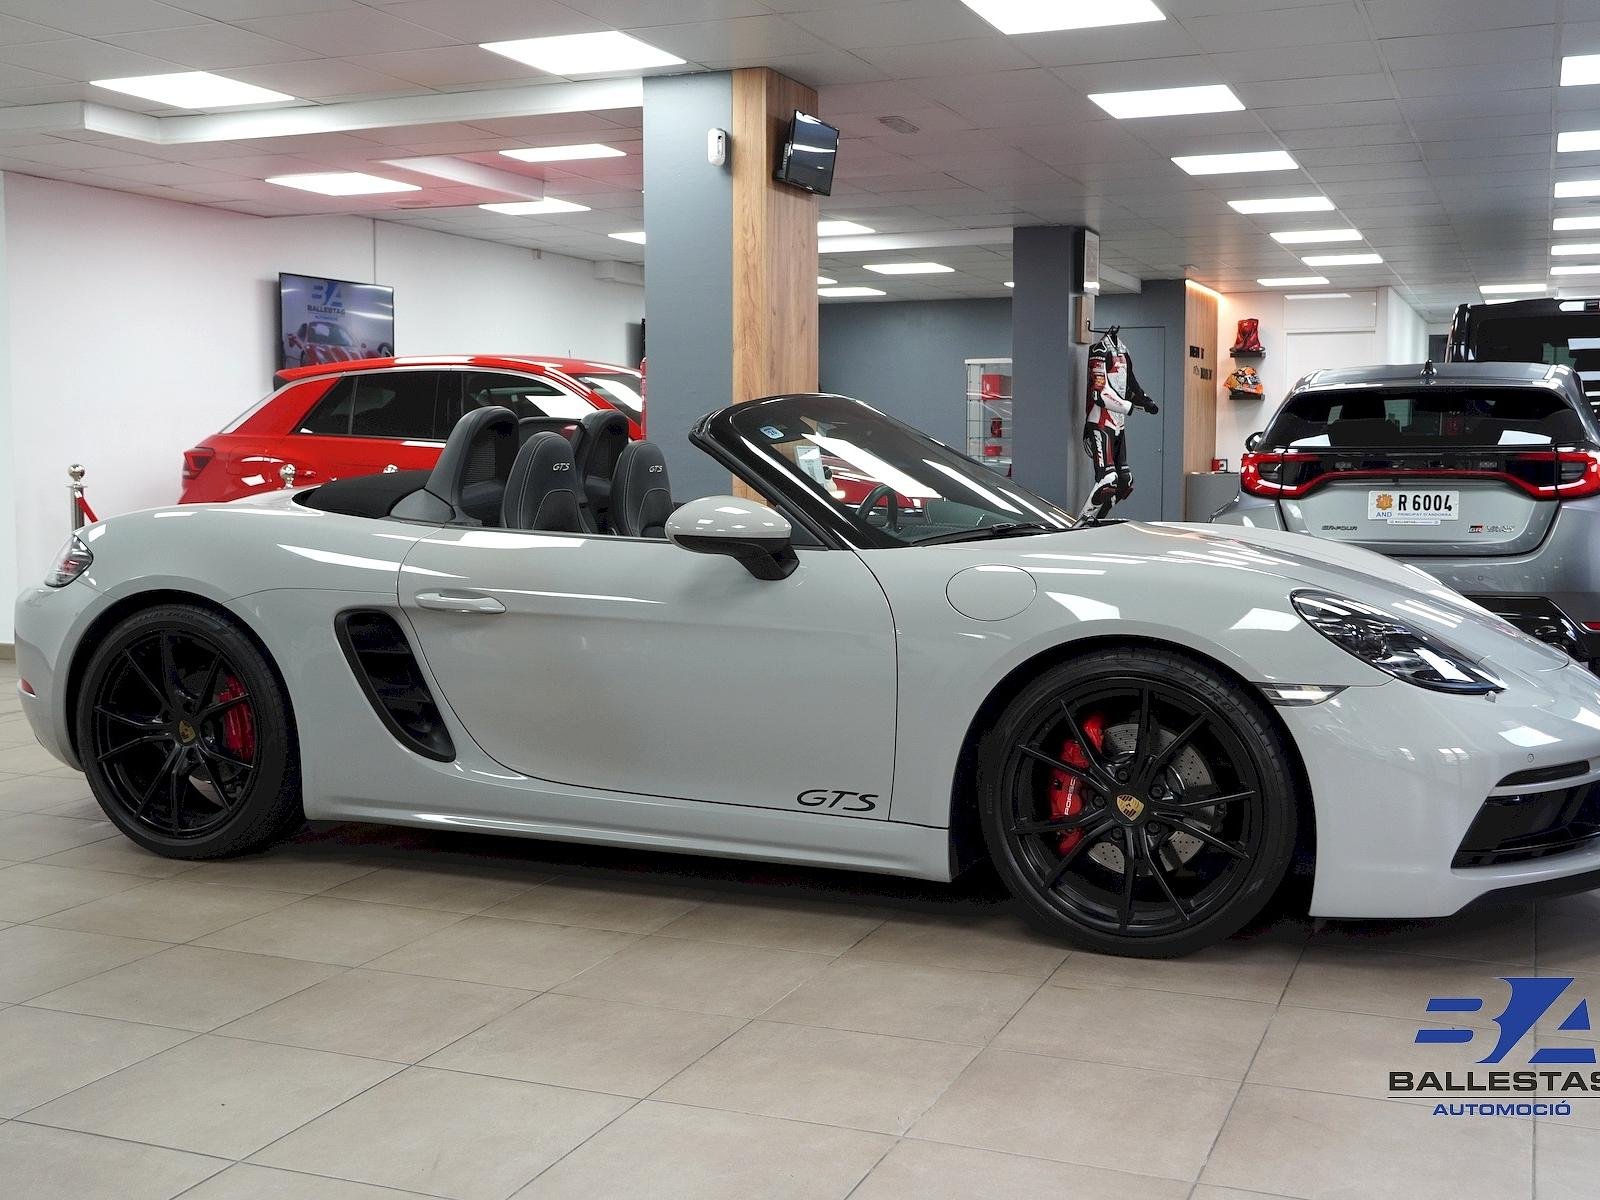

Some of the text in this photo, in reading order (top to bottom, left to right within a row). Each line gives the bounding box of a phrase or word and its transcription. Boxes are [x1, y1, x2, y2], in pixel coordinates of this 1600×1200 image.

[552, 463, 571, 471] GTS
[648, 465, 663, 473] GTS
[1398, 494, 1452, 511] R 6004
[796, 789, 879, 812] GTS
[1064, 776, 1078, 816] PORSC
